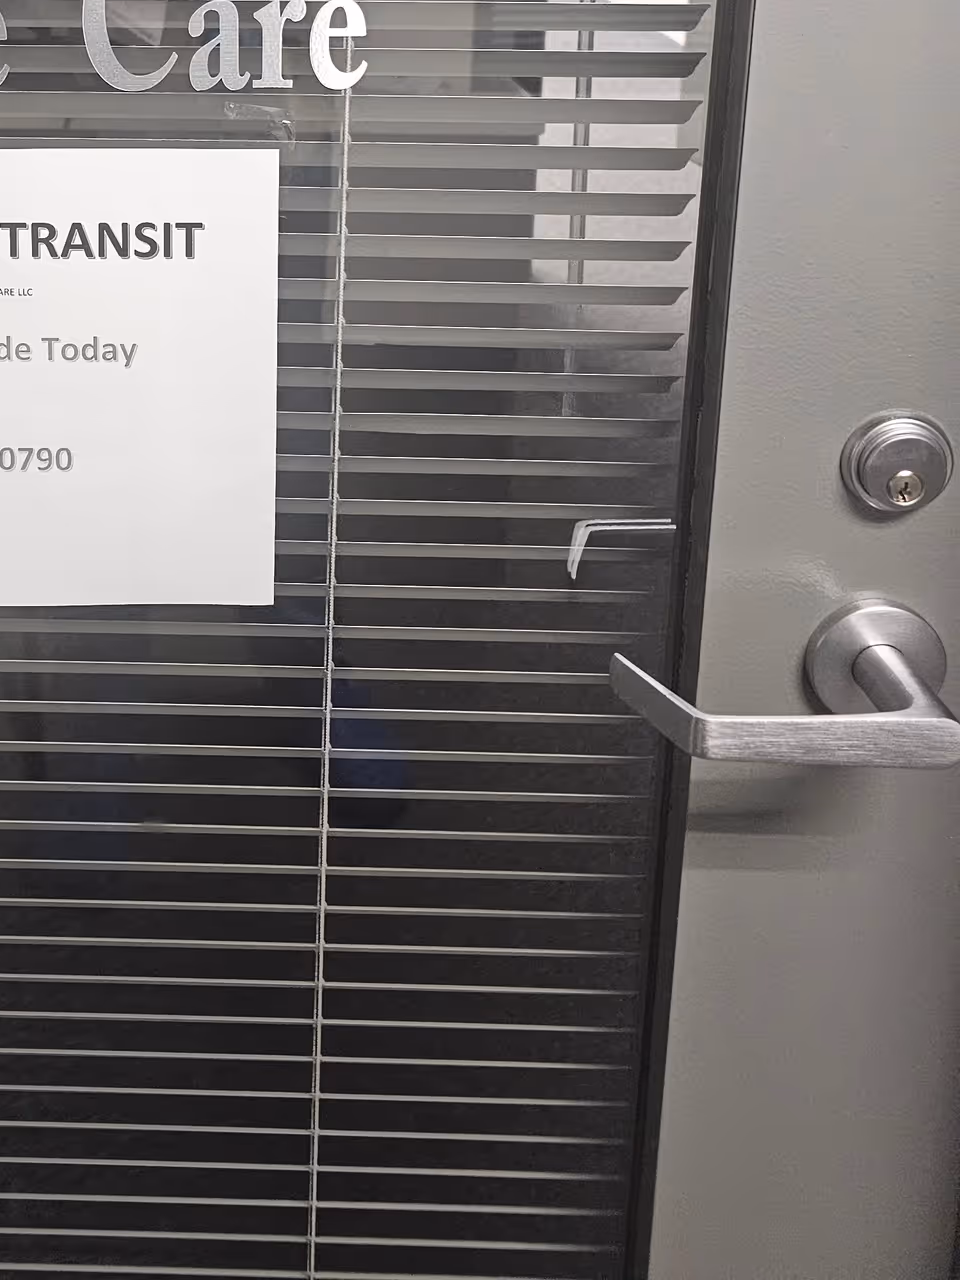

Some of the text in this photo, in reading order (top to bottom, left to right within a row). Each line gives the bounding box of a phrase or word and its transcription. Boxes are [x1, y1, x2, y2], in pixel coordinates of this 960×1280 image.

[0, 221, 205, 260] TRANSIT
[18, 287, 33, 296] LLC
[41, 336, 138, 369] Today
